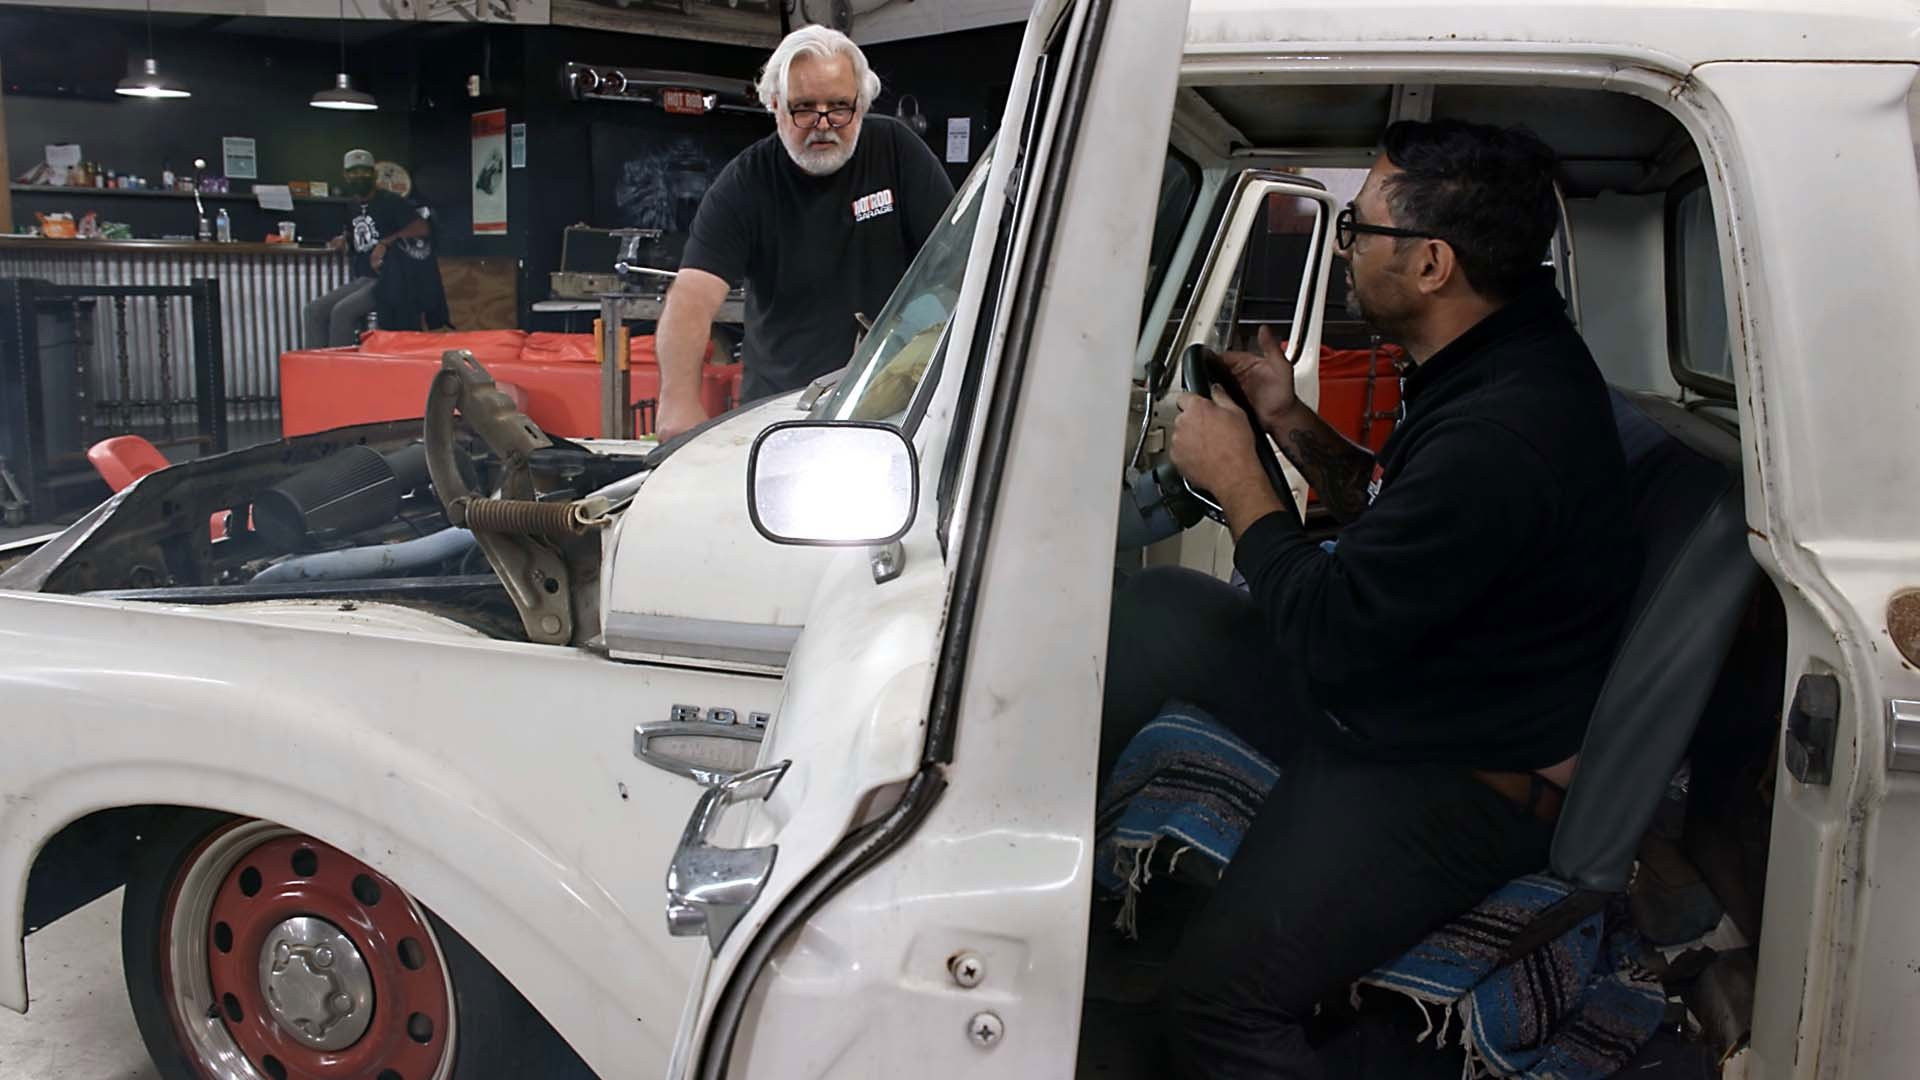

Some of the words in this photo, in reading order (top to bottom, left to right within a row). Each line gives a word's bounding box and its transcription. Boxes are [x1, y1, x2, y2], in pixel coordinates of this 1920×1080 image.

[663, 91, 682, 107] HOT
[685, 93, 702, 108] ROD
[852, 195, 870, 216] HOT
[869, 189, 893, 209] ROD
[856, 204, 894, 221] GARAGE
[671, 703, 771, 729] FOR
